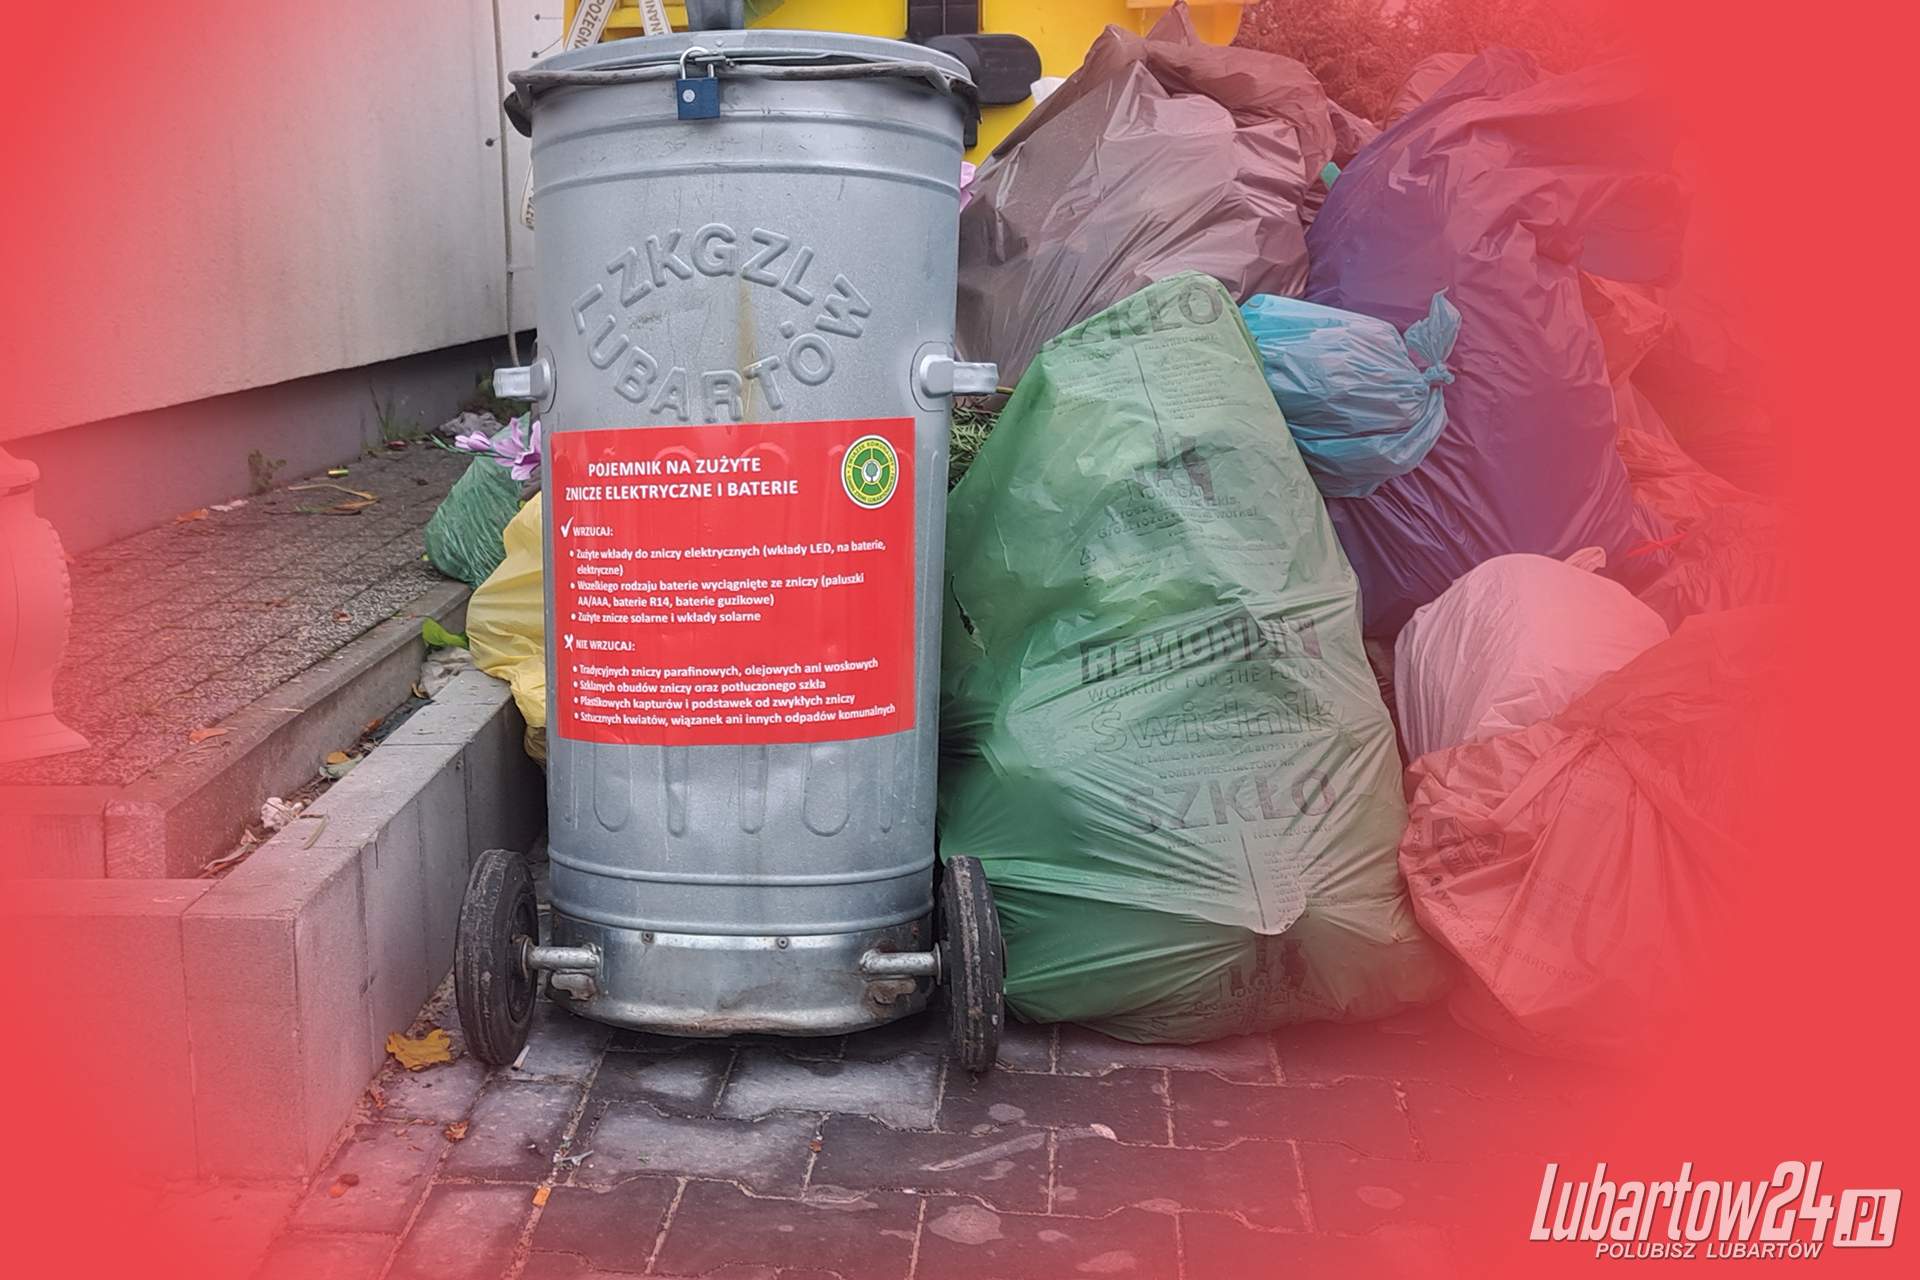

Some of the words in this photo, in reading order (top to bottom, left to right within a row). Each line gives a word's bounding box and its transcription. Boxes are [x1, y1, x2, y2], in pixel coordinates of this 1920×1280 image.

[606, 223, 815, 308] ZKGZL
[571, 273, 872, 423] LUBARTÓW
[588, 460, 662, 477] POJEMNIK
[666, 459, 691, 475] NA
[695, 455, 761, 475] ZUŻYTE
[565, 486, 602, 501] ZNICZE
[605, 483, 712, 500] ELEKTRYCZNE
[717, 483, 722, 497] I
[727, 480, 799, 497] BATERIE
[573, 526, 614, 537] WRZUCAJ:
[576, 548, 600, 560] Zużyte
[601, 548, 632, 561] wkłady
[635, 548, 648, 559] do
[650, 548, 682, 560] zniczy
[684, 545, 760, 559] elektrycznych
[763, 545, 807, 557] (wkłady
[810, 542, 834, 555] LED,
[837, 542, 849, 552] na
[851, 539, 886, 551] baterie,
[577, 564, 624, 576] elektryczne)
[577, 580, 619, 593] Wszelkiego
[621, 580, 657, 592] rodzaju
[660, 579, 698, 590] baterie
[701, 577, 768, 592] wyciągnięte
[771, 579, 782, 588] ze
[785, 576, 818, 588] zniczy
[821, 572, 865, 587] (paluszki
[578, 596, 612, 608] AA/AAA,
[613, 596, 647, 607] baterie
[650, 596, 673, 608] R14,
[675, 595, 714, 606] baterie
[717, 593, 775, 608] guzikowe)
[578, 611, 600, 623] Zużyte
[602, 612, 628, 622] znicze
[631, 611, 668, 623] solarne
[671, 612, 675, 622] i
[677, 611, 717, 624] wkłady
[719, 611, 761, 622] solarne
[576, 639, 588, 650] NIE
[589, 640, 636, 651] WRZUCAJ:
[579, 664, 629, 678] Tradycyjnych
[631, 667, 661, 678] zniczy
[664, 665, 742, 678] parafinowych,
[744, 663, 801, 677] olejowych
[804, 662, 822, 673] ani
[824, 658, 878, 672] woskowych
[1185, 671, 1217, 689] FOR
[1221, 665, 1260, 685] THE
[579, 680, 615, 692] Szklanych
[617, 682, 657, 693] obudów
[660, 682, 692, 694] zniczy
[694, 684, 718, 693] oraz
[721, 680, 796, 694] potłuczonego
[799, 679, 826, 690] szkła
[580, 696, 631, 710] Plastikowych
[633, 698, 682, 711] kapturów
[685, 698, 689, 709] i
[691, 697, 753, 711] podstawek
[755, 697, 770, 707] od
[772, 695, 823, 708] zwykłych
[825, 693, 855, 705] zniczy
[580, 712, 621, 725] Sztucznych
[623, 713, 668, 727] kwiatów,
[671, 714, 722, 727] wiązanek
[725, 713, 743, 724] ani
[746, 712, 782, 725] innych
[784, 711, 836, 725] odpadów
[838, 703, 895, 720] komunalnych
